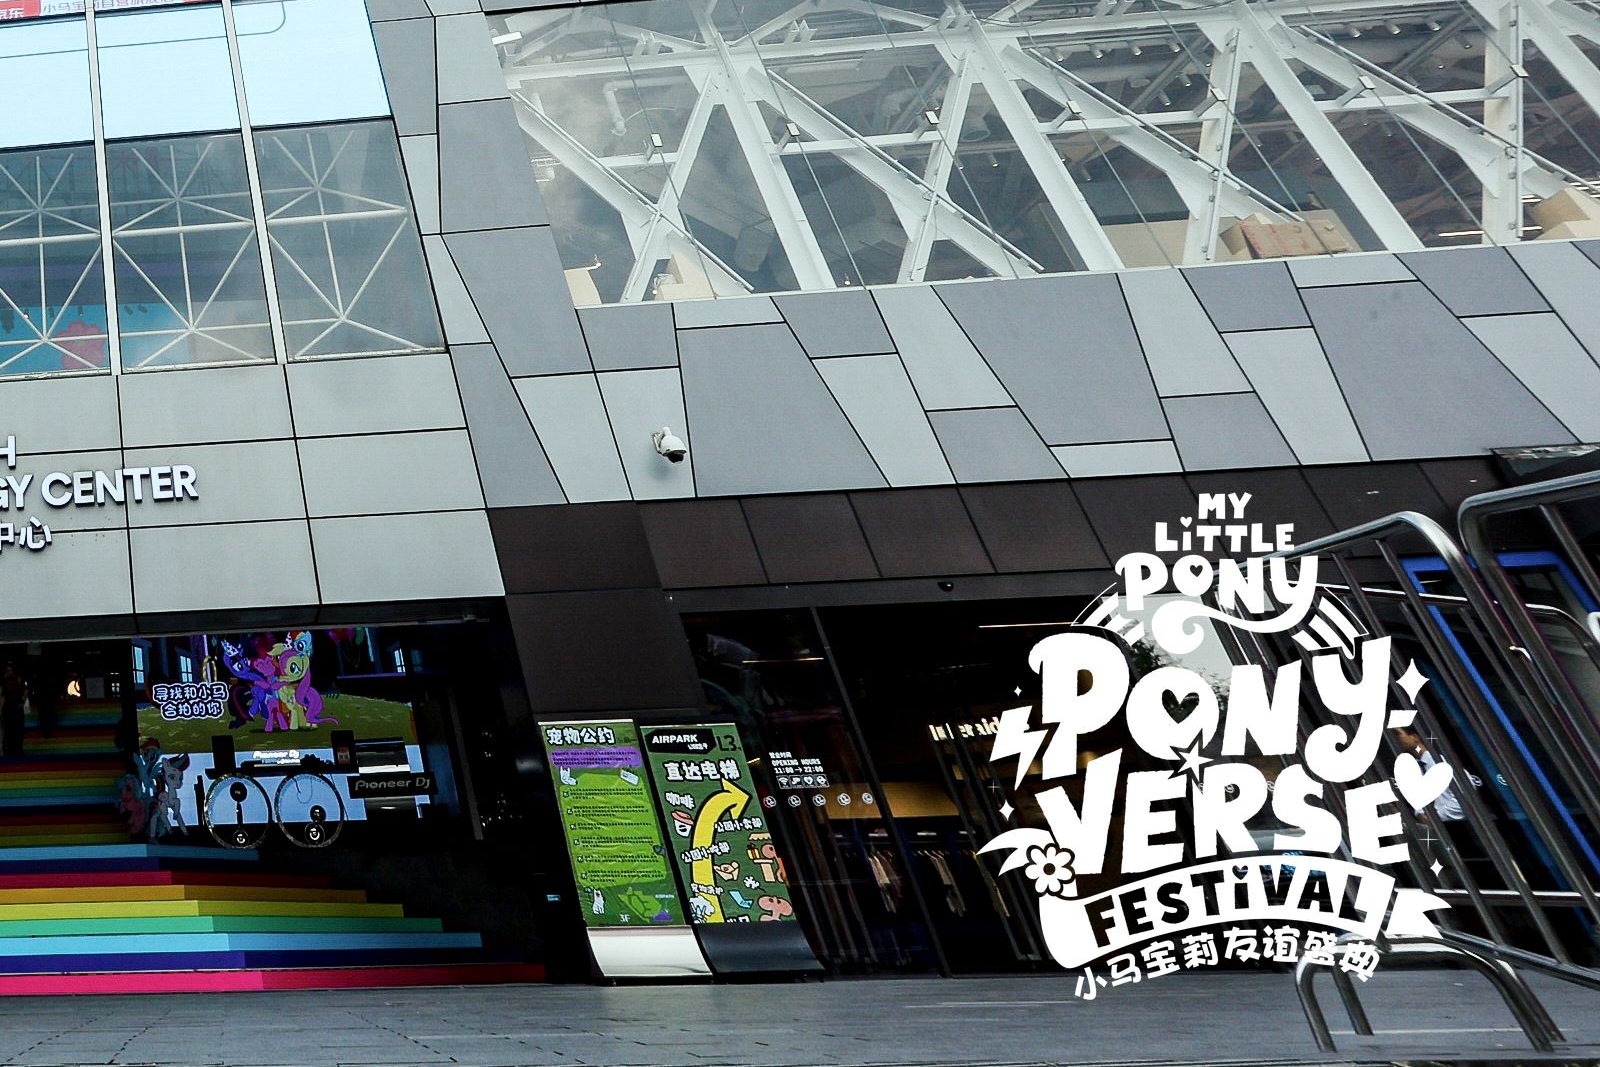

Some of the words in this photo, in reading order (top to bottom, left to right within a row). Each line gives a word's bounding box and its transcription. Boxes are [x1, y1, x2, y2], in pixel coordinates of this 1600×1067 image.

[41, 465, 199, 507] CENTER
[154, 684, 228, 702] 寻找和小马
[163, 701, 223, 718] 合拍的你
[547, 727, 615, 745] 宠物公约
[652, 734, 698, 743] AIRPARK
[664, 759, 741, 781] 直达电梯
[355, 779, 411, 791] Pioneer
